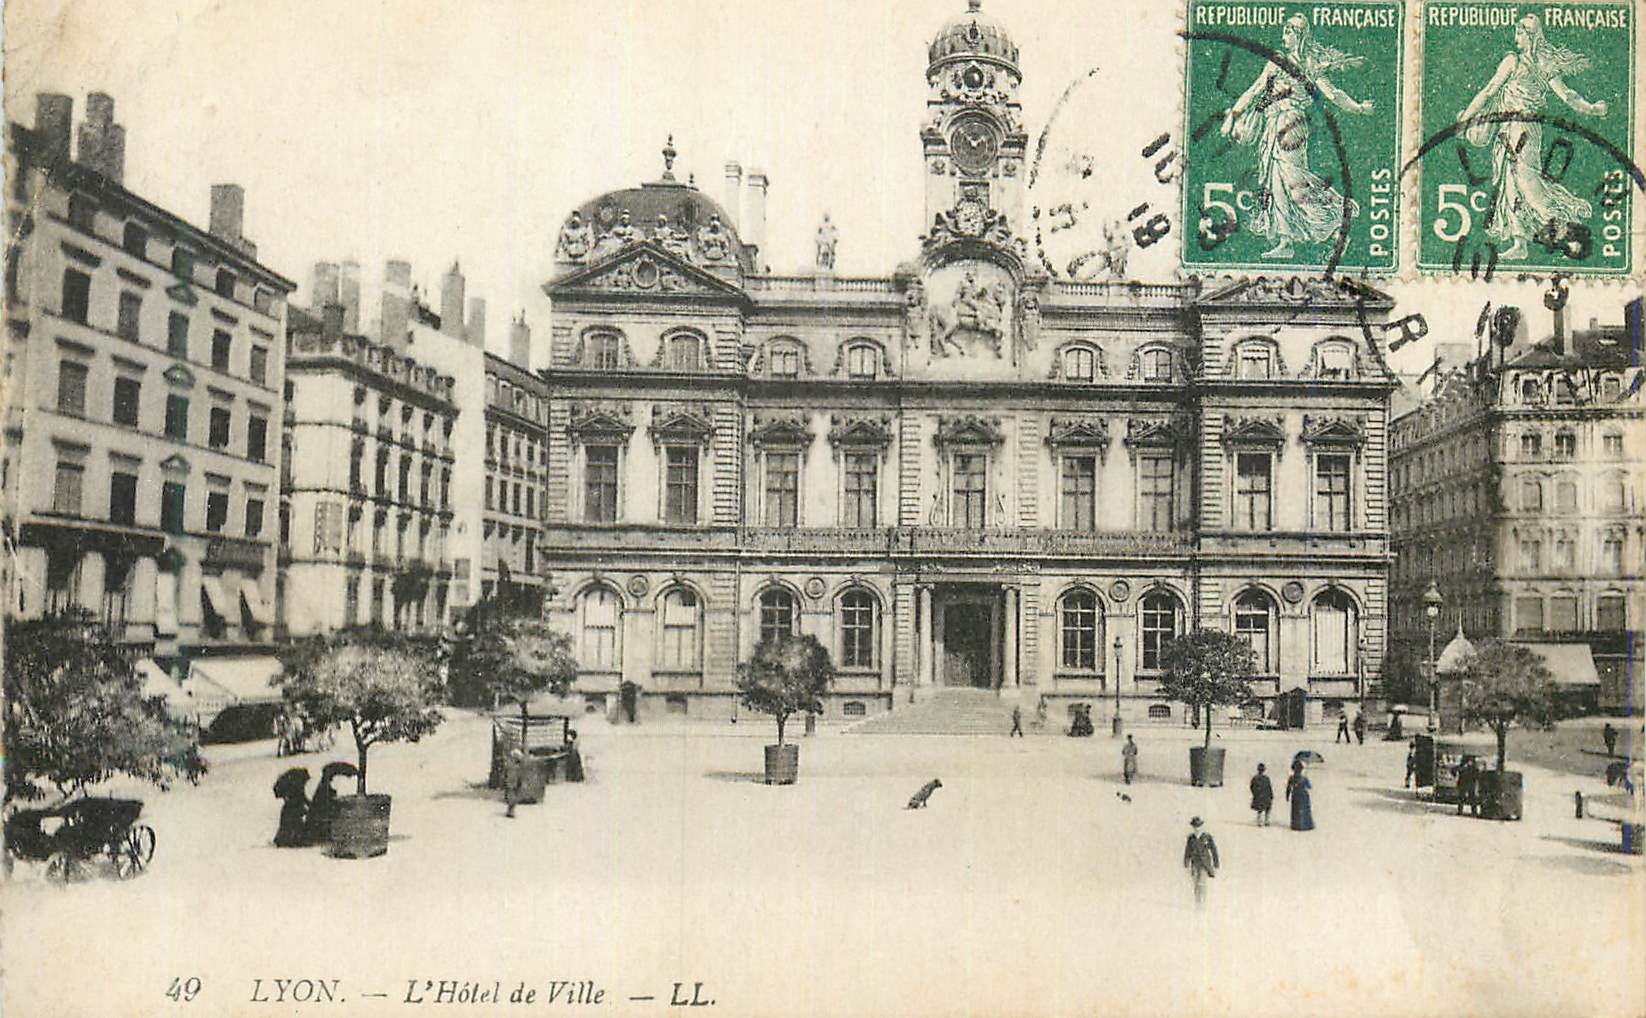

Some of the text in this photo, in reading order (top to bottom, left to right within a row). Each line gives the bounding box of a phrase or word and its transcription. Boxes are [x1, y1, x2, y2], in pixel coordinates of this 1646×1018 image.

[1312, 7, 1396, 30] FRANÇAISE
[1545, 8, 1628, 30] FRANÇAISE
[1369, 167, 1392, 257] POSTES
